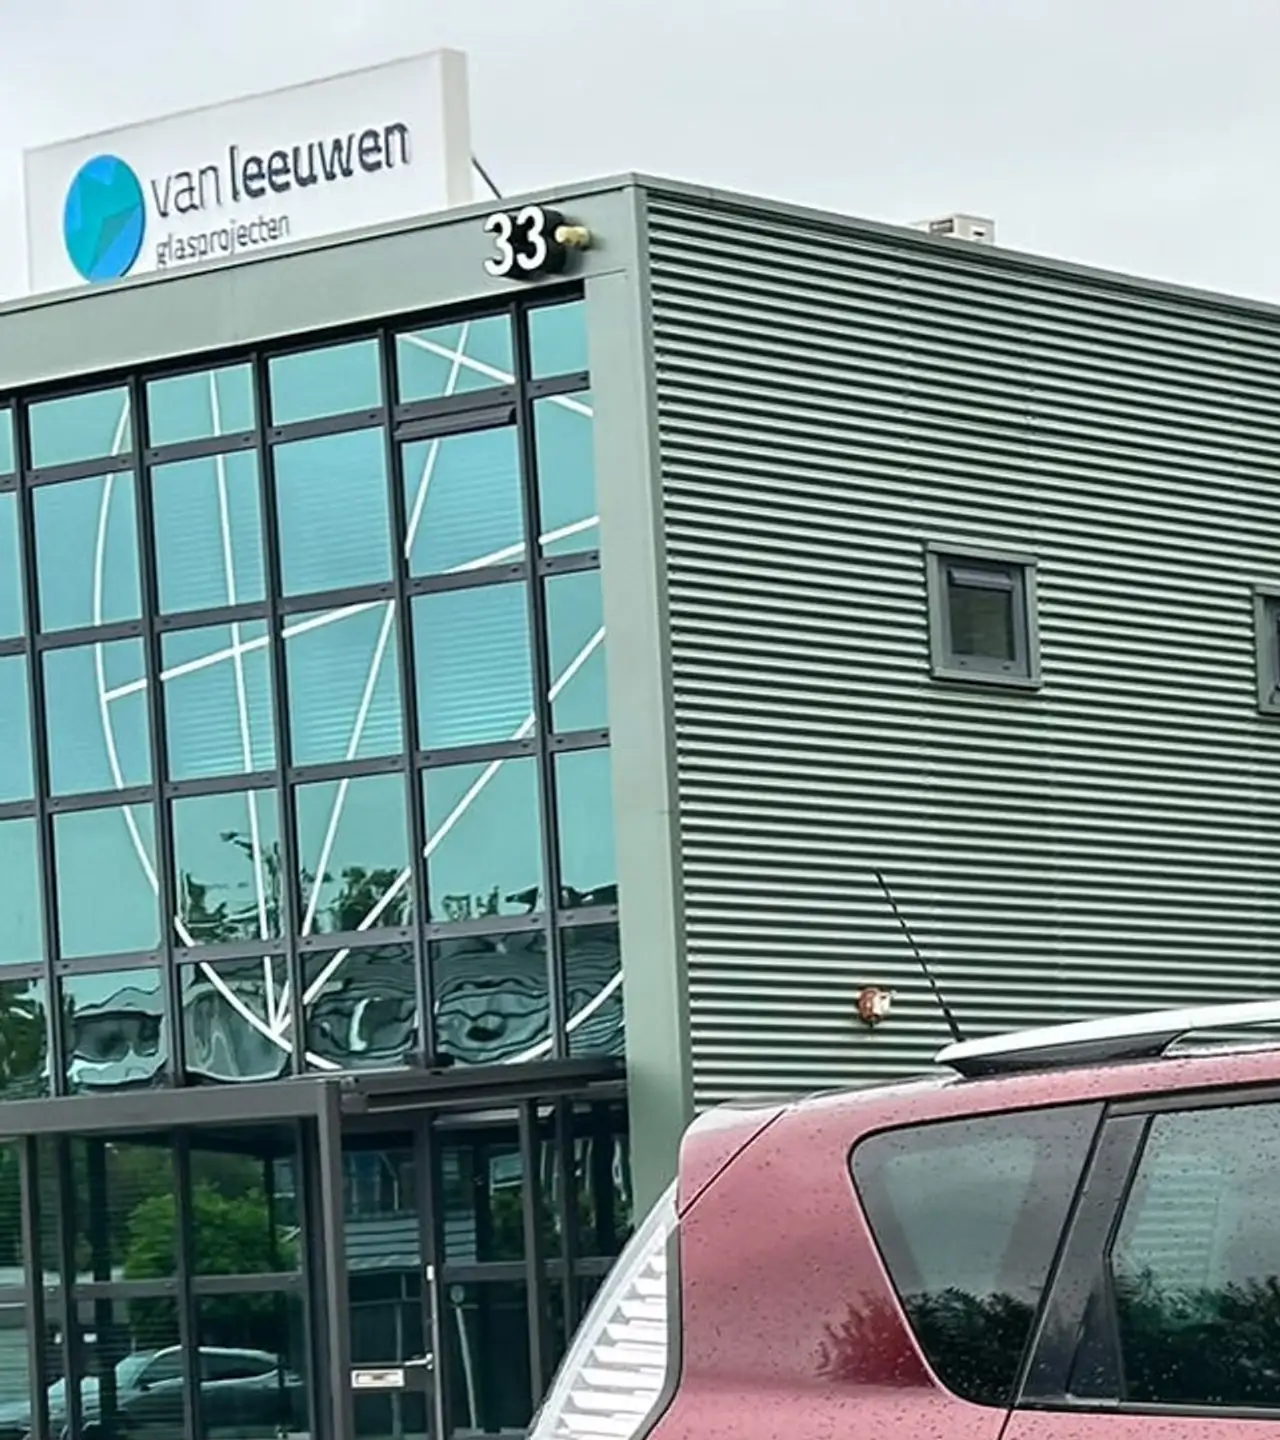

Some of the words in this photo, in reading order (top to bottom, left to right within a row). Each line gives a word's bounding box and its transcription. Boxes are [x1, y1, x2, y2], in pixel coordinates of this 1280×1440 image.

[150, 165, 222, 218] van
[228, 122, 410, 203] leeuwen
[155, 214, 290, 270] glasprojecten
[484, 205, 547, 277] 33
